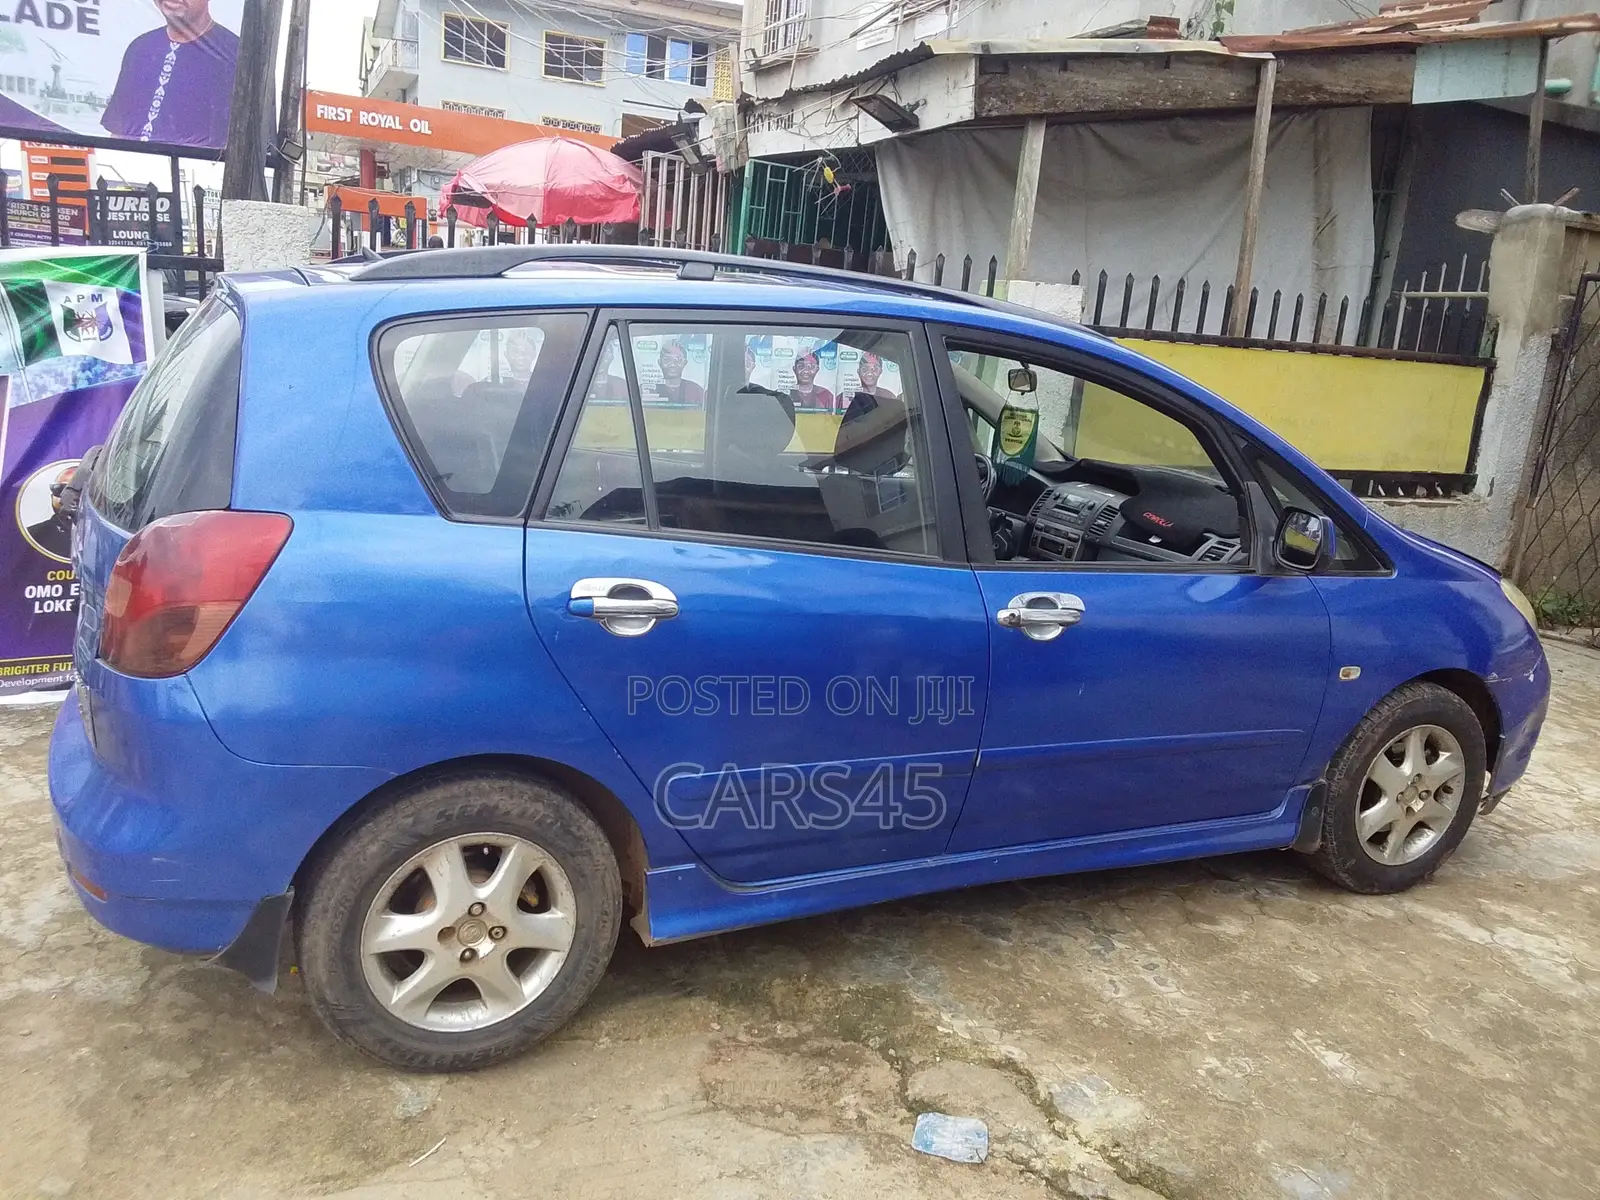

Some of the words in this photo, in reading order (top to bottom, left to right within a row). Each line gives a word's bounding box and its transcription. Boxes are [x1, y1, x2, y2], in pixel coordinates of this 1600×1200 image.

[316, 104, 353, 122] FIRST
[360, 110, 403, 130] ROYAL
[409, 118, 433, 135] OIL
[134, 213, 171, 223] HOSE
[113, 230, 149, 240] LOUNG
[47, 570, 78, 581] COU
[24, 584, 63, 599] OMO
